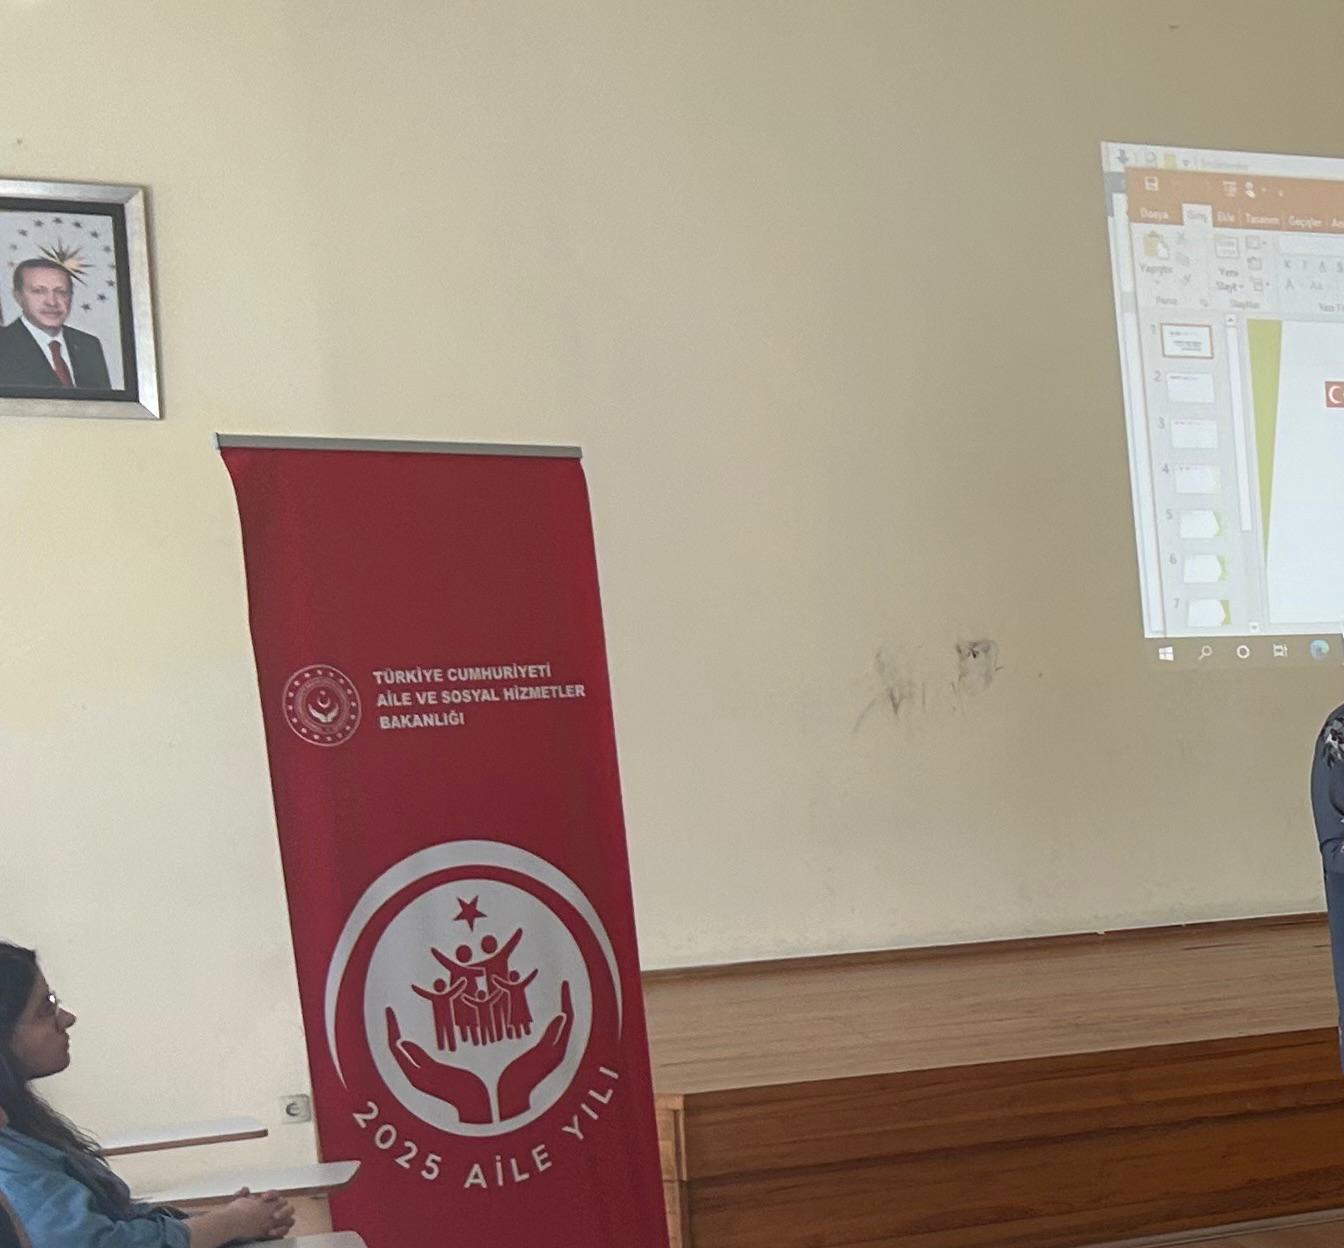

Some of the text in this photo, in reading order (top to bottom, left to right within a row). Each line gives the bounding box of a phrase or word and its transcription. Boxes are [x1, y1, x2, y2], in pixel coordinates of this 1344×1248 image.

[372, 661, 552, 685] TÜRKİYE CUMHURİYETİ
[377, 683, 586, 707] AİLE VE SOSYAL HİZMETLER
[380, 711, 465, 730] BAKANLIĞI
[352, 1065, 619, 1189] 2025 AİLE YILI
